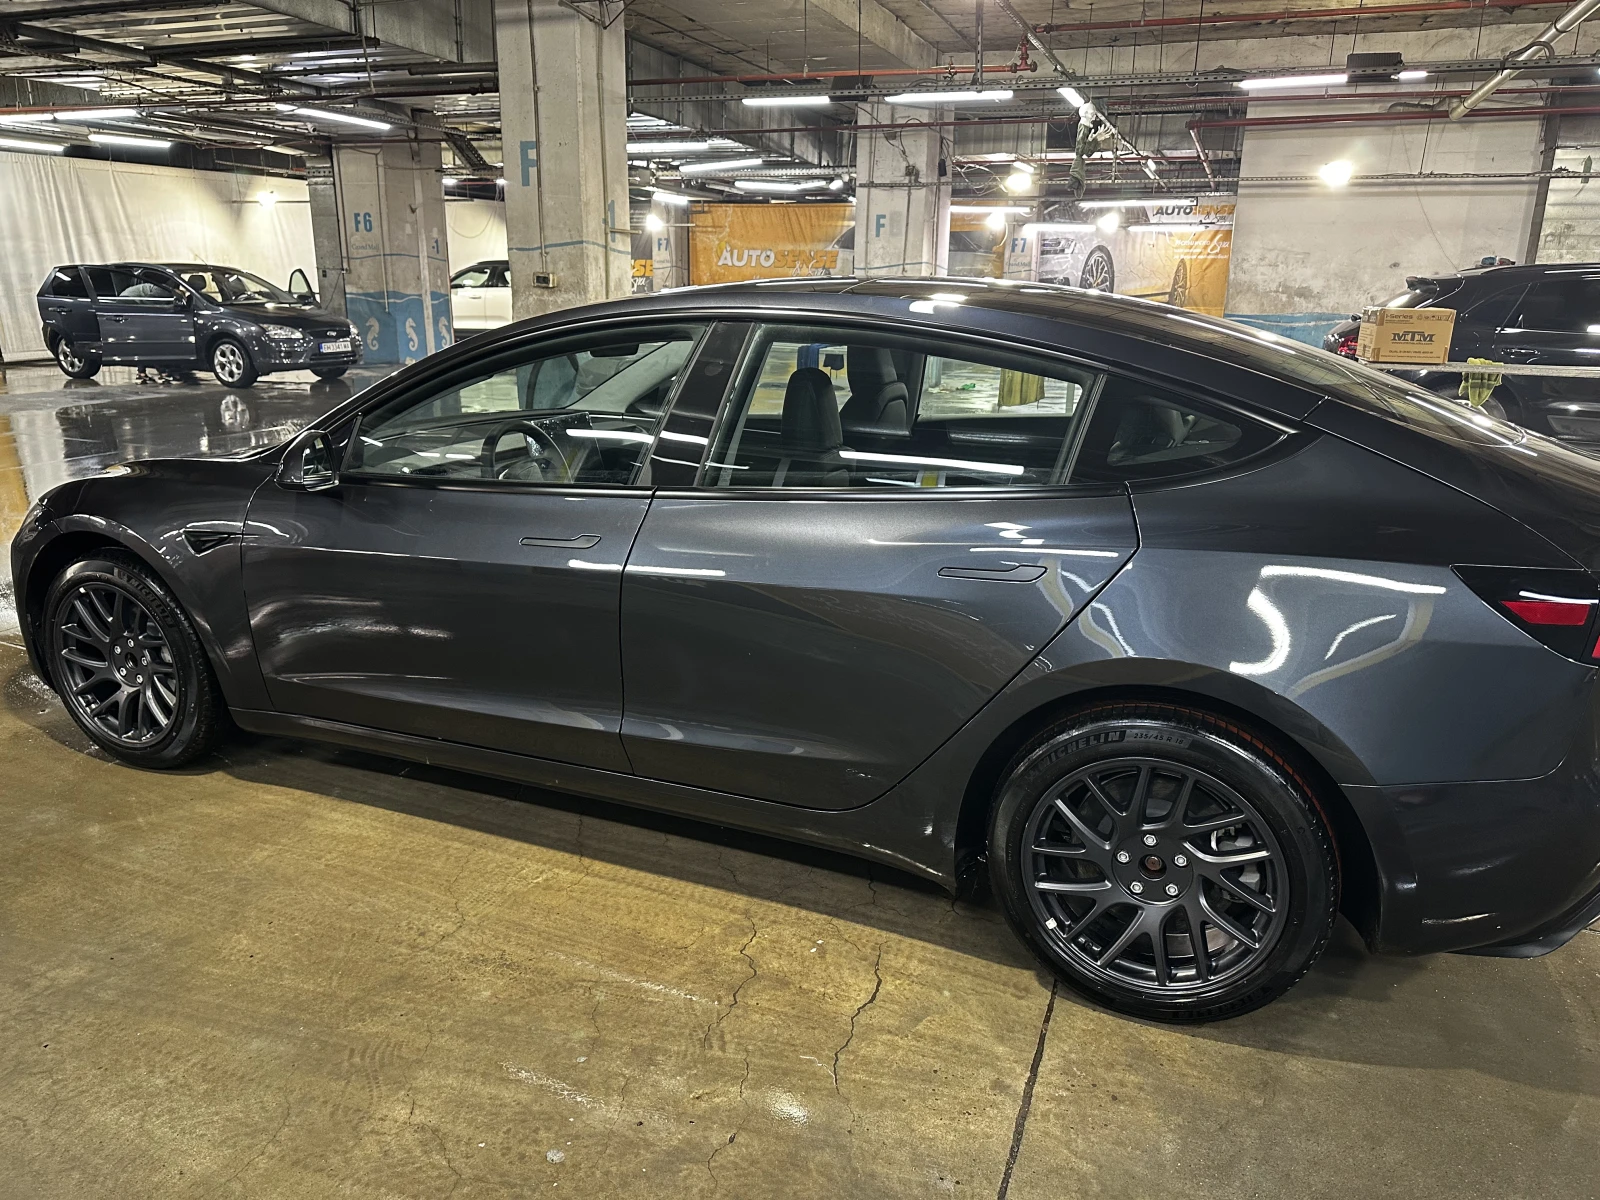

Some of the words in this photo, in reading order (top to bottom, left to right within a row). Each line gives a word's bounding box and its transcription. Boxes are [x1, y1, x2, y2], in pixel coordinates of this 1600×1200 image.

[520, 141, 538, 186] F
[717, 248, 839, 269] AUTOSENSE
[1391, 331, 1436, 342] MTM
